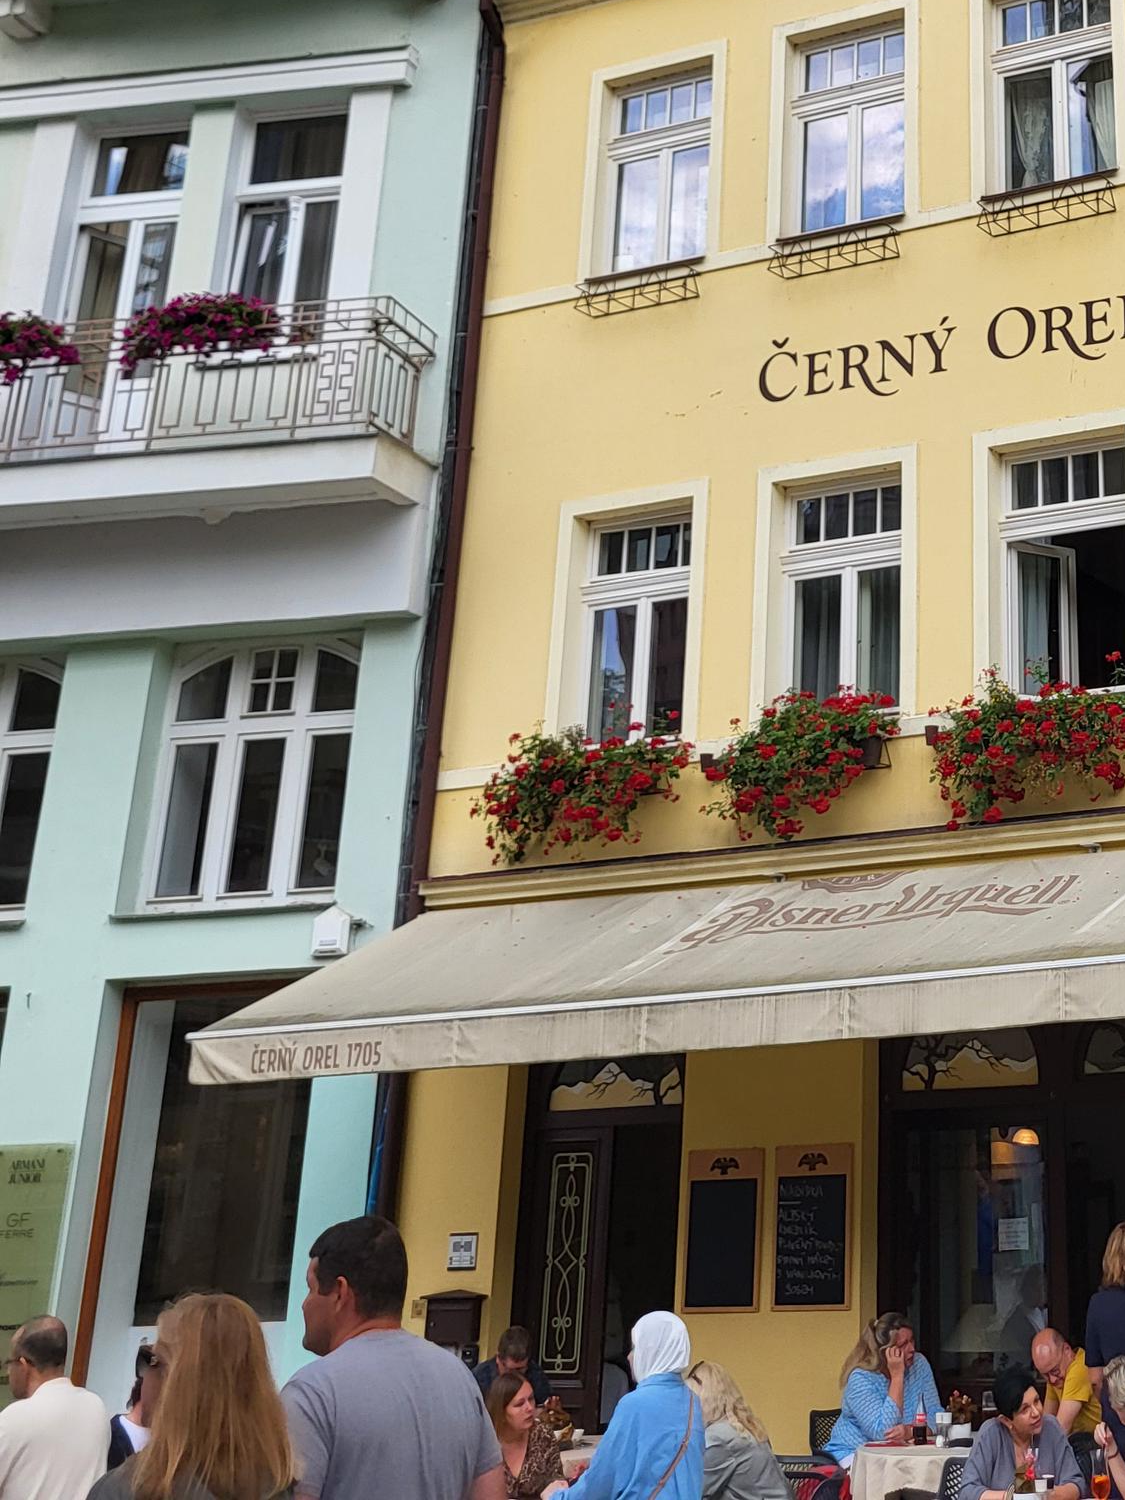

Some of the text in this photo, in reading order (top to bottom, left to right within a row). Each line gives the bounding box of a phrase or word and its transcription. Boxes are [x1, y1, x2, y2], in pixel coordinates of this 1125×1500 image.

[758, 316, 957, 402] ČERNÝ
[662, 874, 1080, 955] Pilsner Urquell
[251, 1041, 382, 1074] ČERNÝ OREL 1705
[6, 1212, 32, 1228] GF
